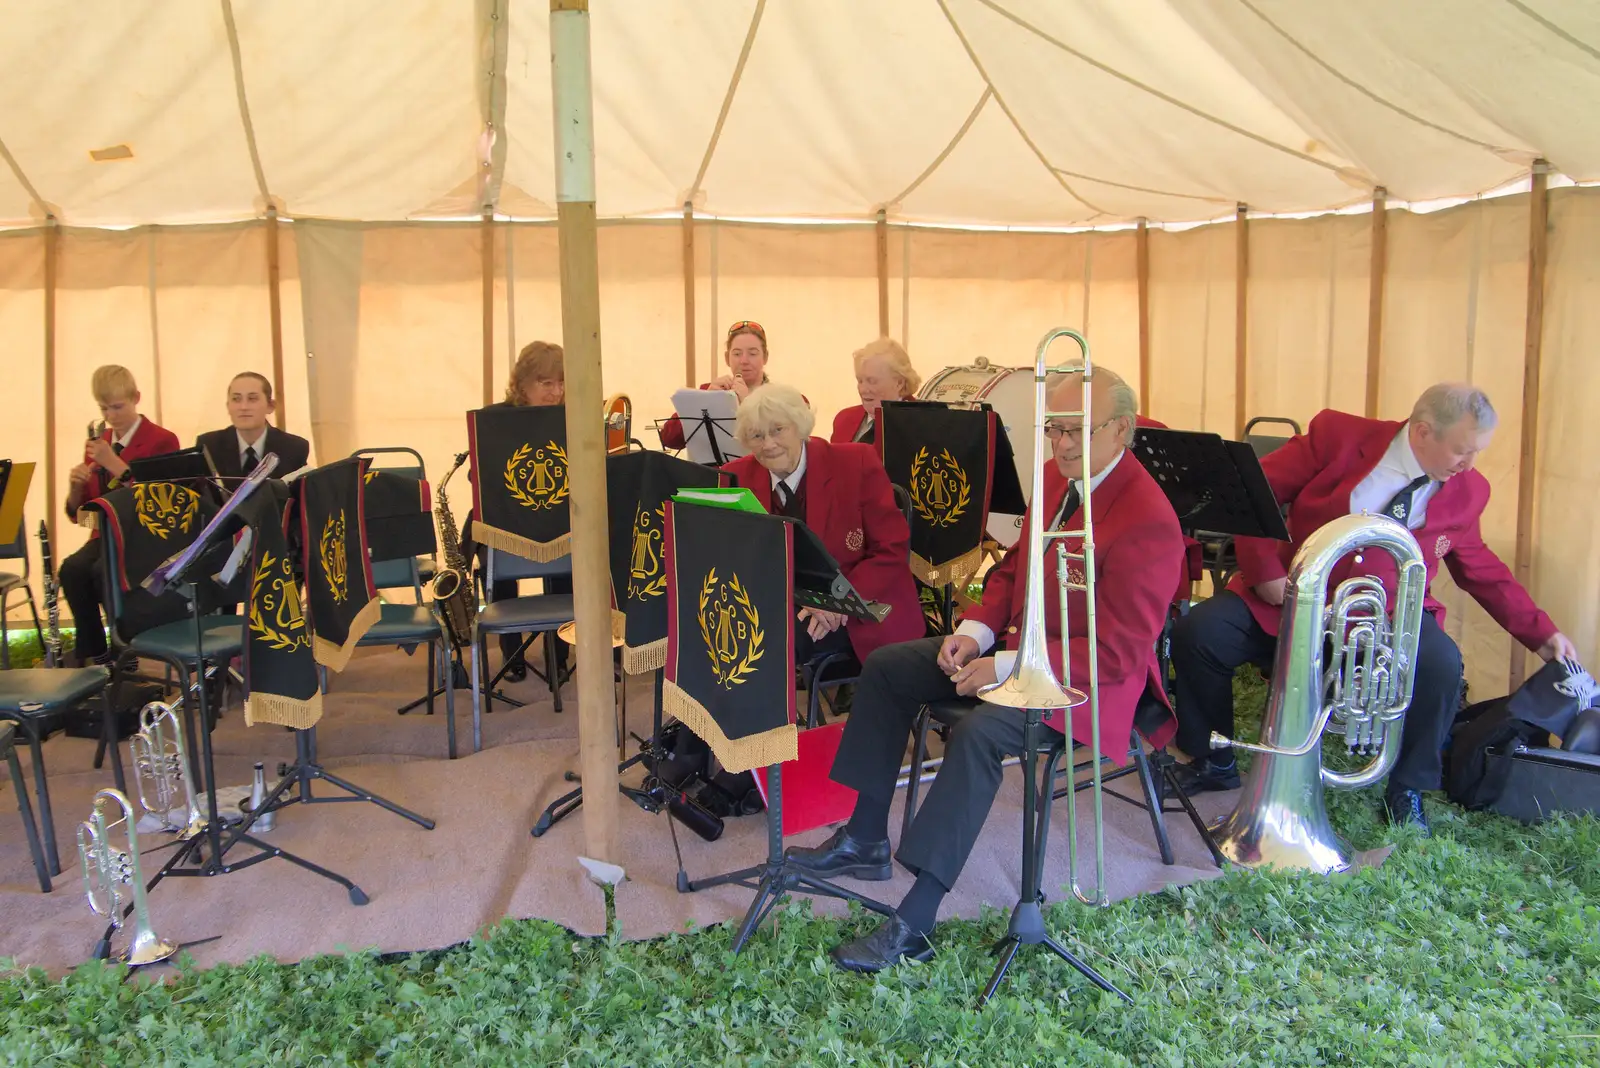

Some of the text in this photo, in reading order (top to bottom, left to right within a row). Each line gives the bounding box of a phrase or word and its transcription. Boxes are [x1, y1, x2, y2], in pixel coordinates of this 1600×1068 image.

[519, 448, 563, 480] S G B
[920, 456, 957, 493] S G B
[640, 511, 650, 527] G
[263, 558, 291, 611] S G
[708, 583, 747, 640] S G B
